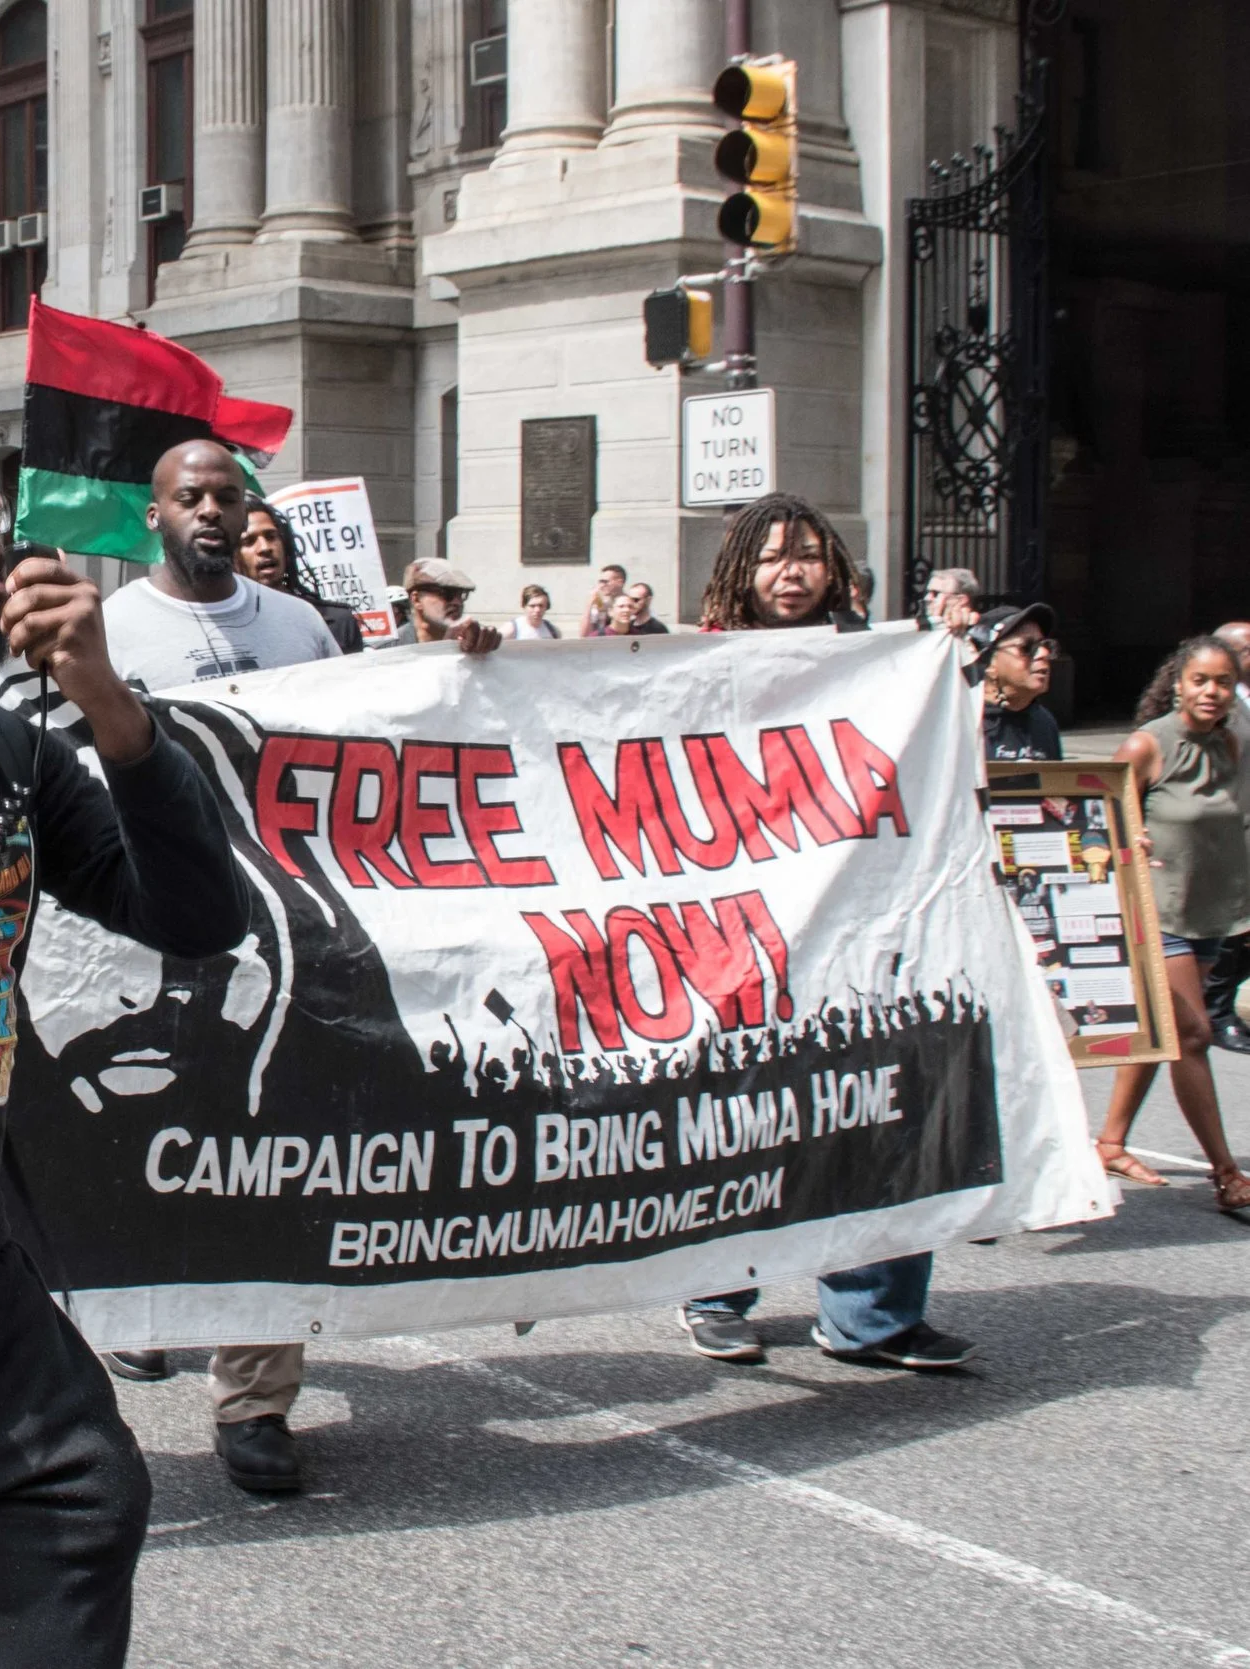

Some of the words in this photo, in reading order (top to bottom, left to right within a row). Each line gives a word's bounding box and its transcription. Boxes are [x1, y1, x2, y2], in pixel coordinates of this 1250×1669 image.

[712, 405, 743, 427] NO
[701, 437, 757, 459] TURN
[694, 471, 721, 491] ON
[727, 467, 764, 491] RED
[286, 501, 336, 526] FREE
[341, 525, 365, 550] 9!
[334, 563, 358, 579] ALL
[255, 731, 558, 889] FREE
[556, 718, 911, 883] MUMIA
[521, 889, 793, 1054] NOW!
[144, 1126, 436, 1197] CAMPAIGN
[535, 1111, 664, 1184] BRING
[677, 1091, 798, 1166] MUMIA
[812, 1064, 903, 1137] HOME
[328, 1166, 785, 1268] BRINGMUMIAHOME.COM
